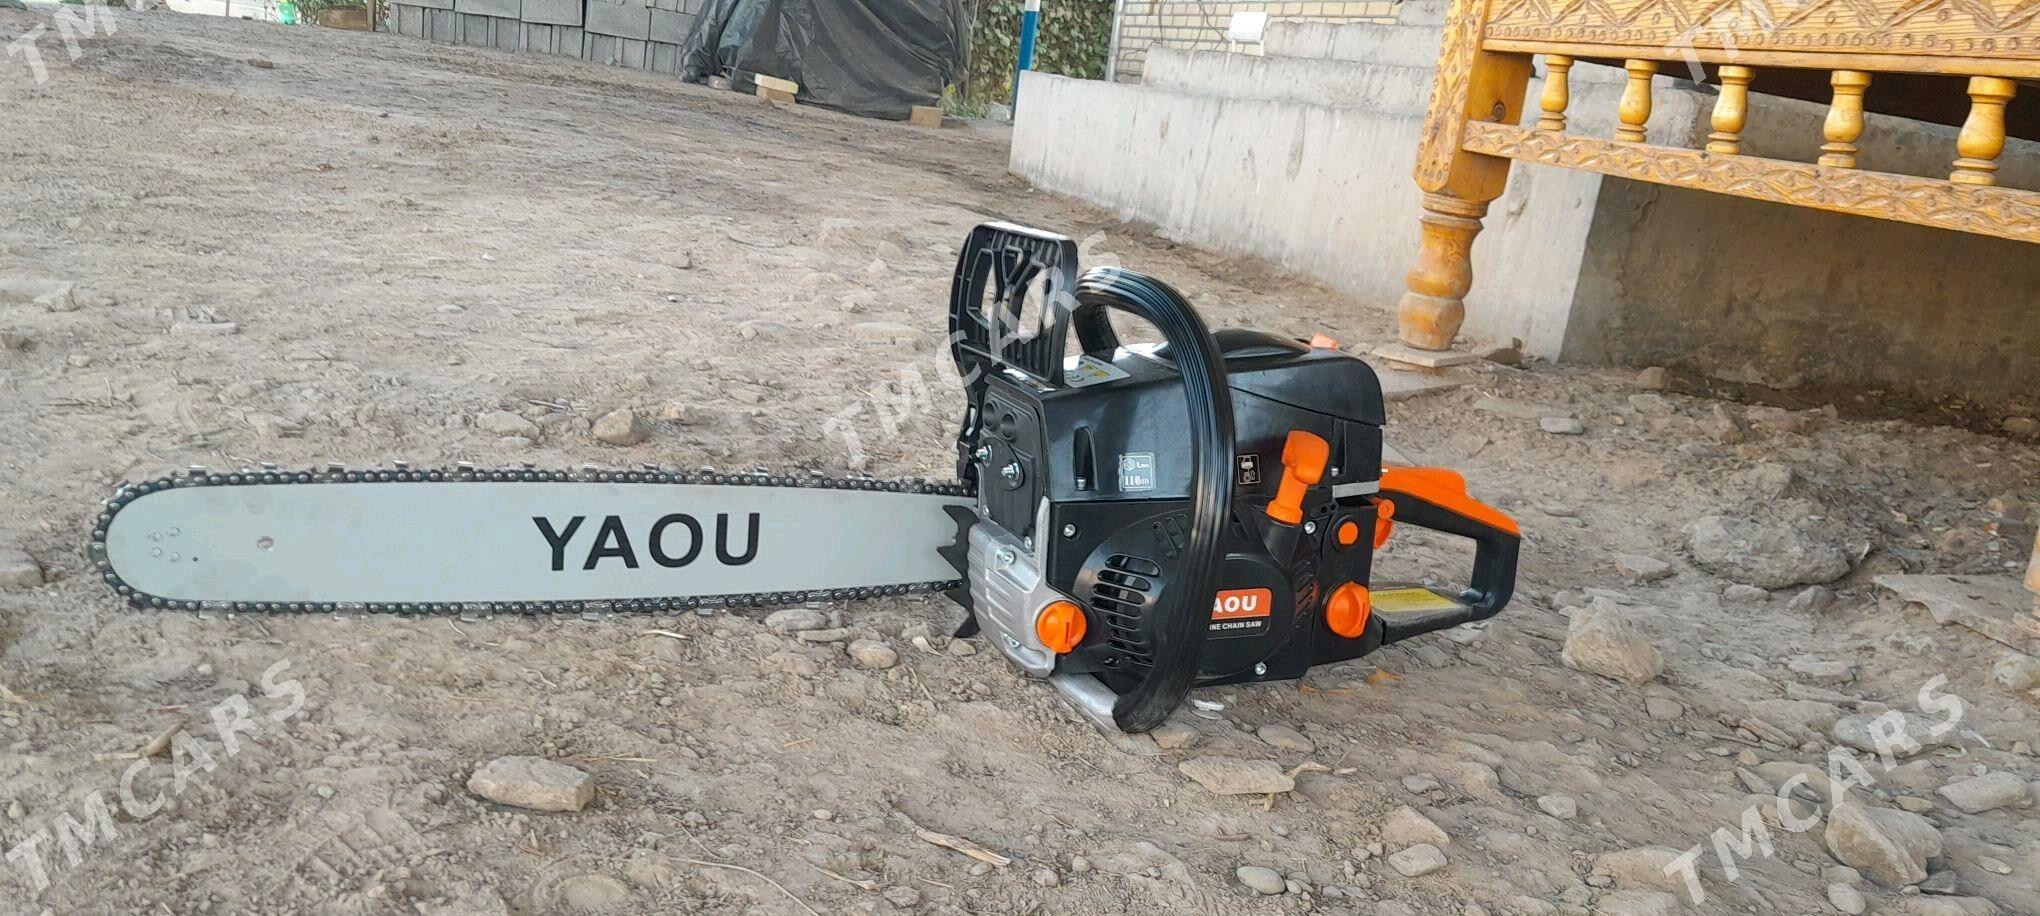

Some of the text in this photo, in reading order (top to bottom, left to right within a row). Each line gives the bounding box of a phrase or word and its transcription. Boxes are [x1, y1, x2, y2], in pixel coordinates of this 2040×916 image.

[532, 512, 761, 571] YAOU
[1222, 621, 1245, 630] CHAIN
[1245, 620, 1262, 628] SAW
